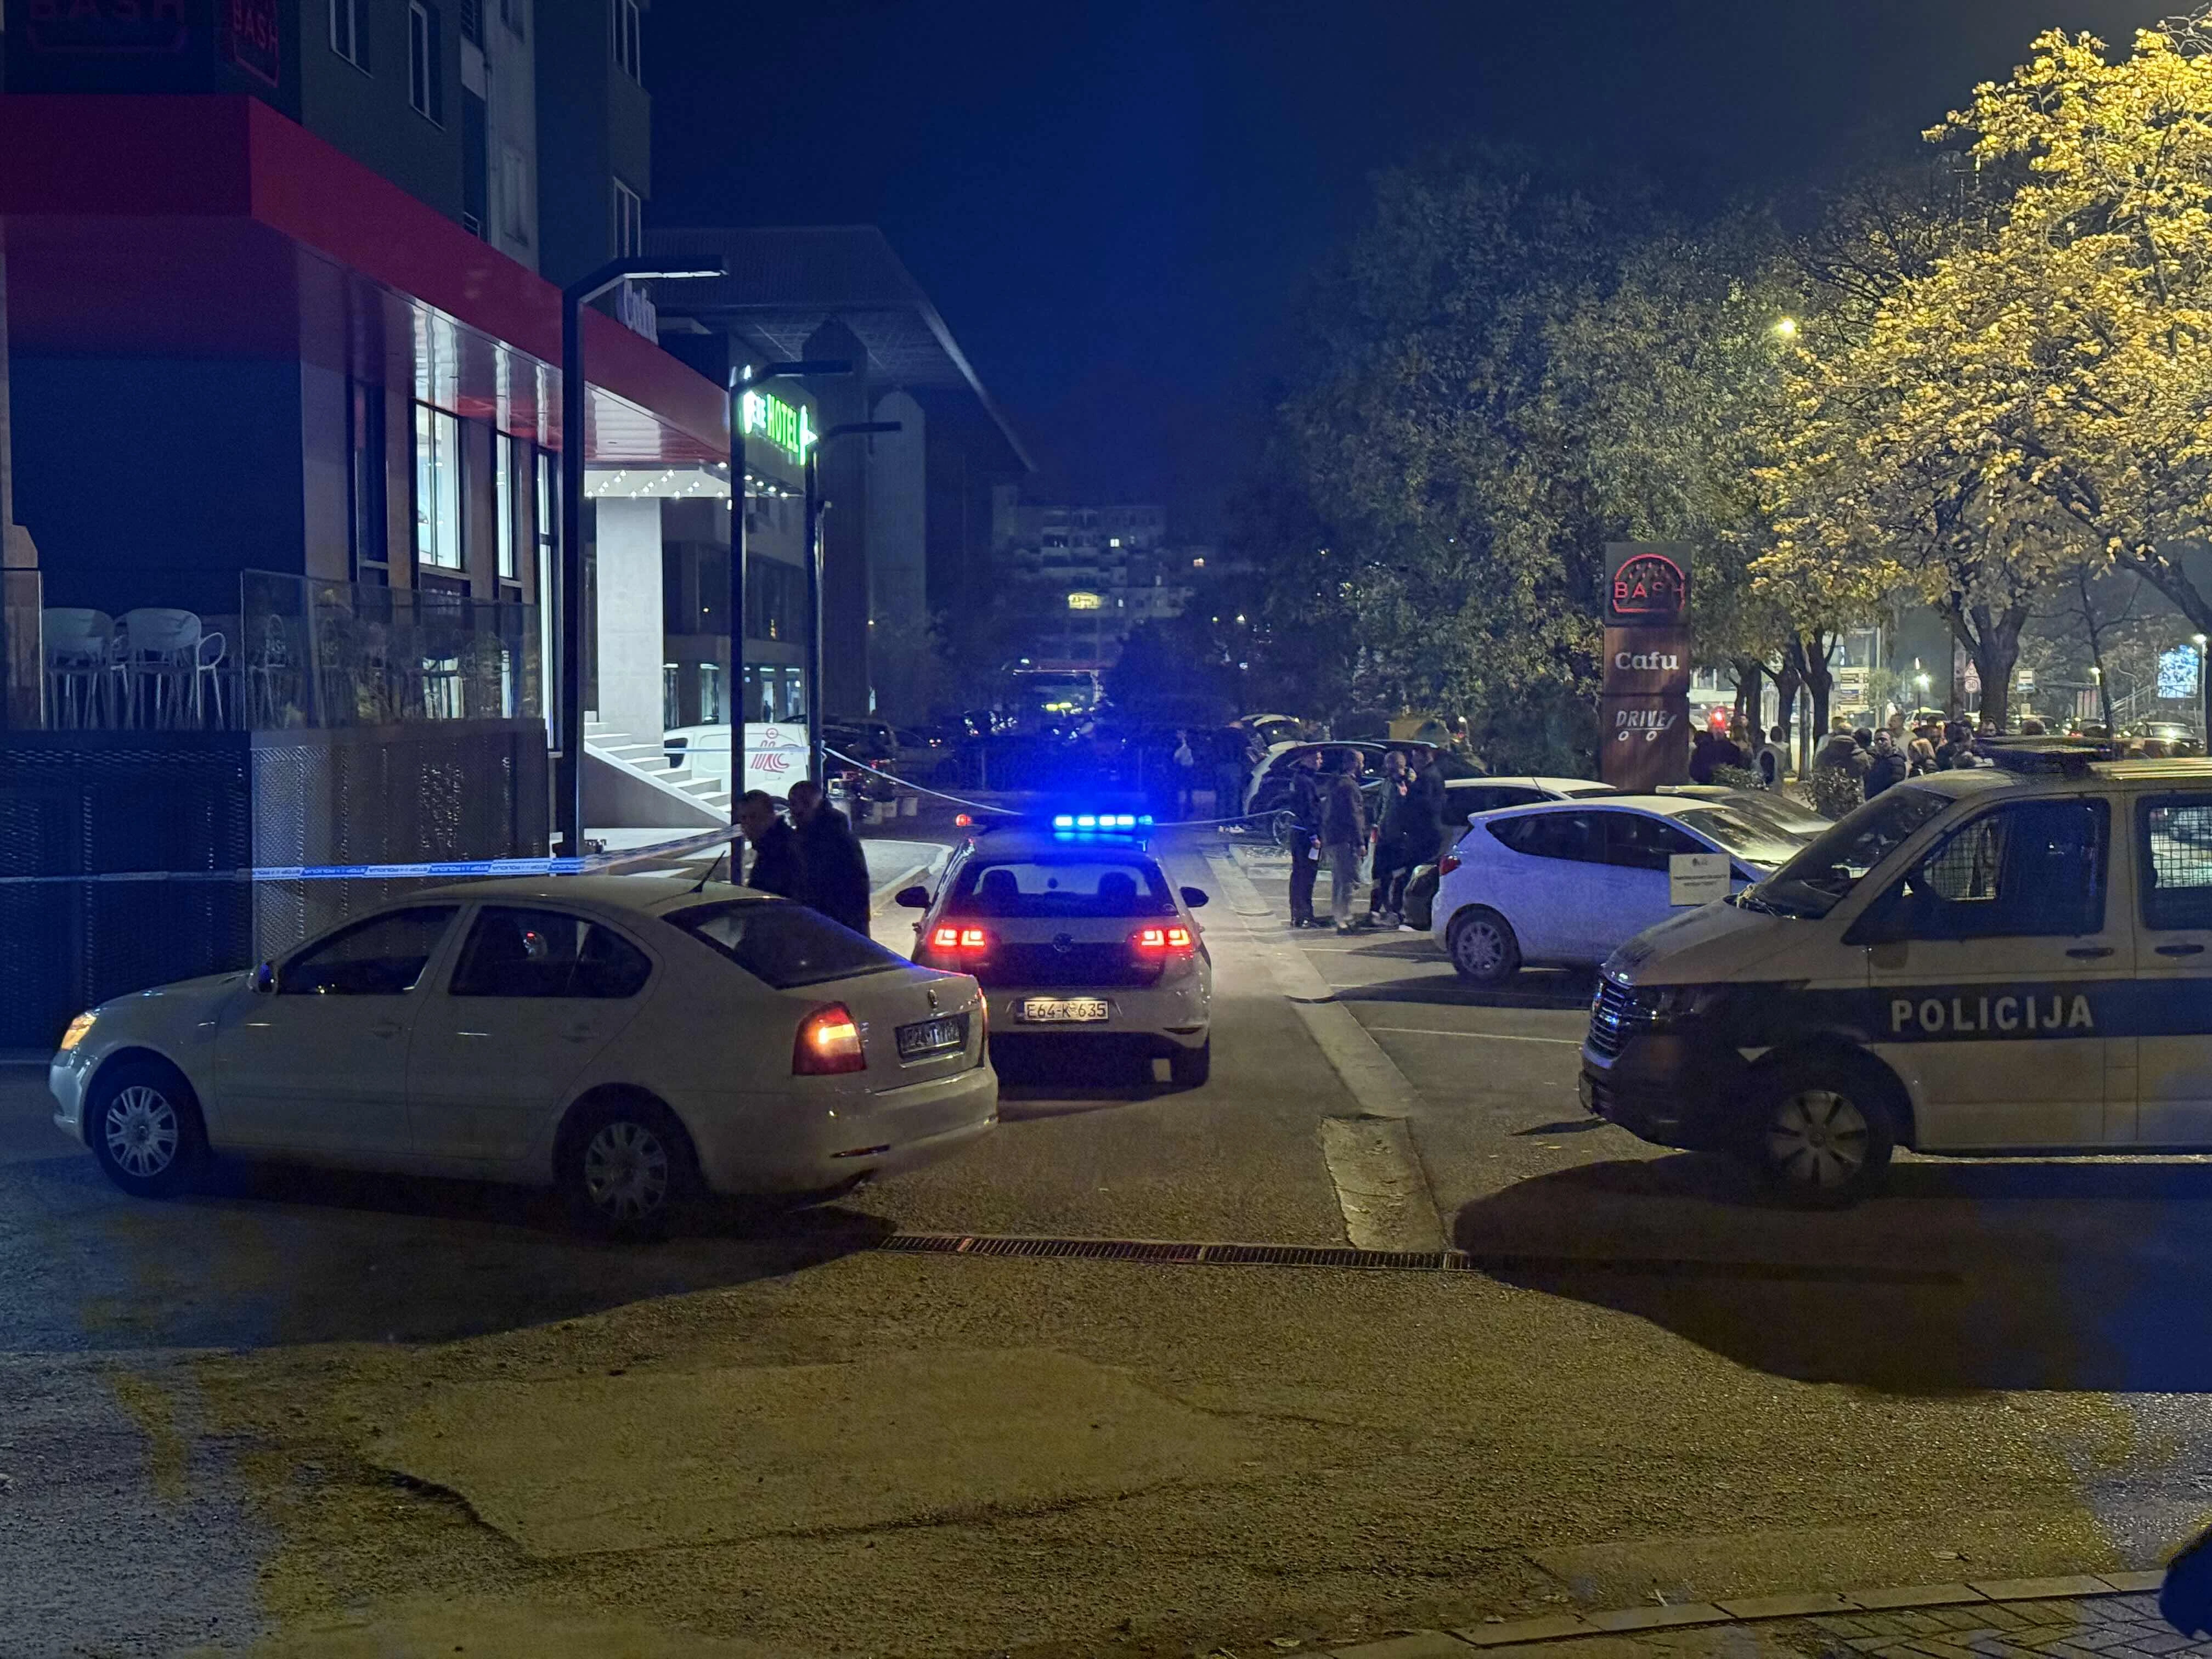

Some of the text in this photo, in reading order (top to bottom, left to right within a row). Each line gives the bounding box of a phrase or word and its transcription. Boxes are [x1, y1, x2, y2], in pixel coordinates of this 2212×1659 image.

[767, 393, 799, 453] HOTEL
[1615, 651, 1680, 670] Cafu
[1616, 710, 1668, 727] DRIVE
[1891, 995, 2094, 1032] POLICIJA
